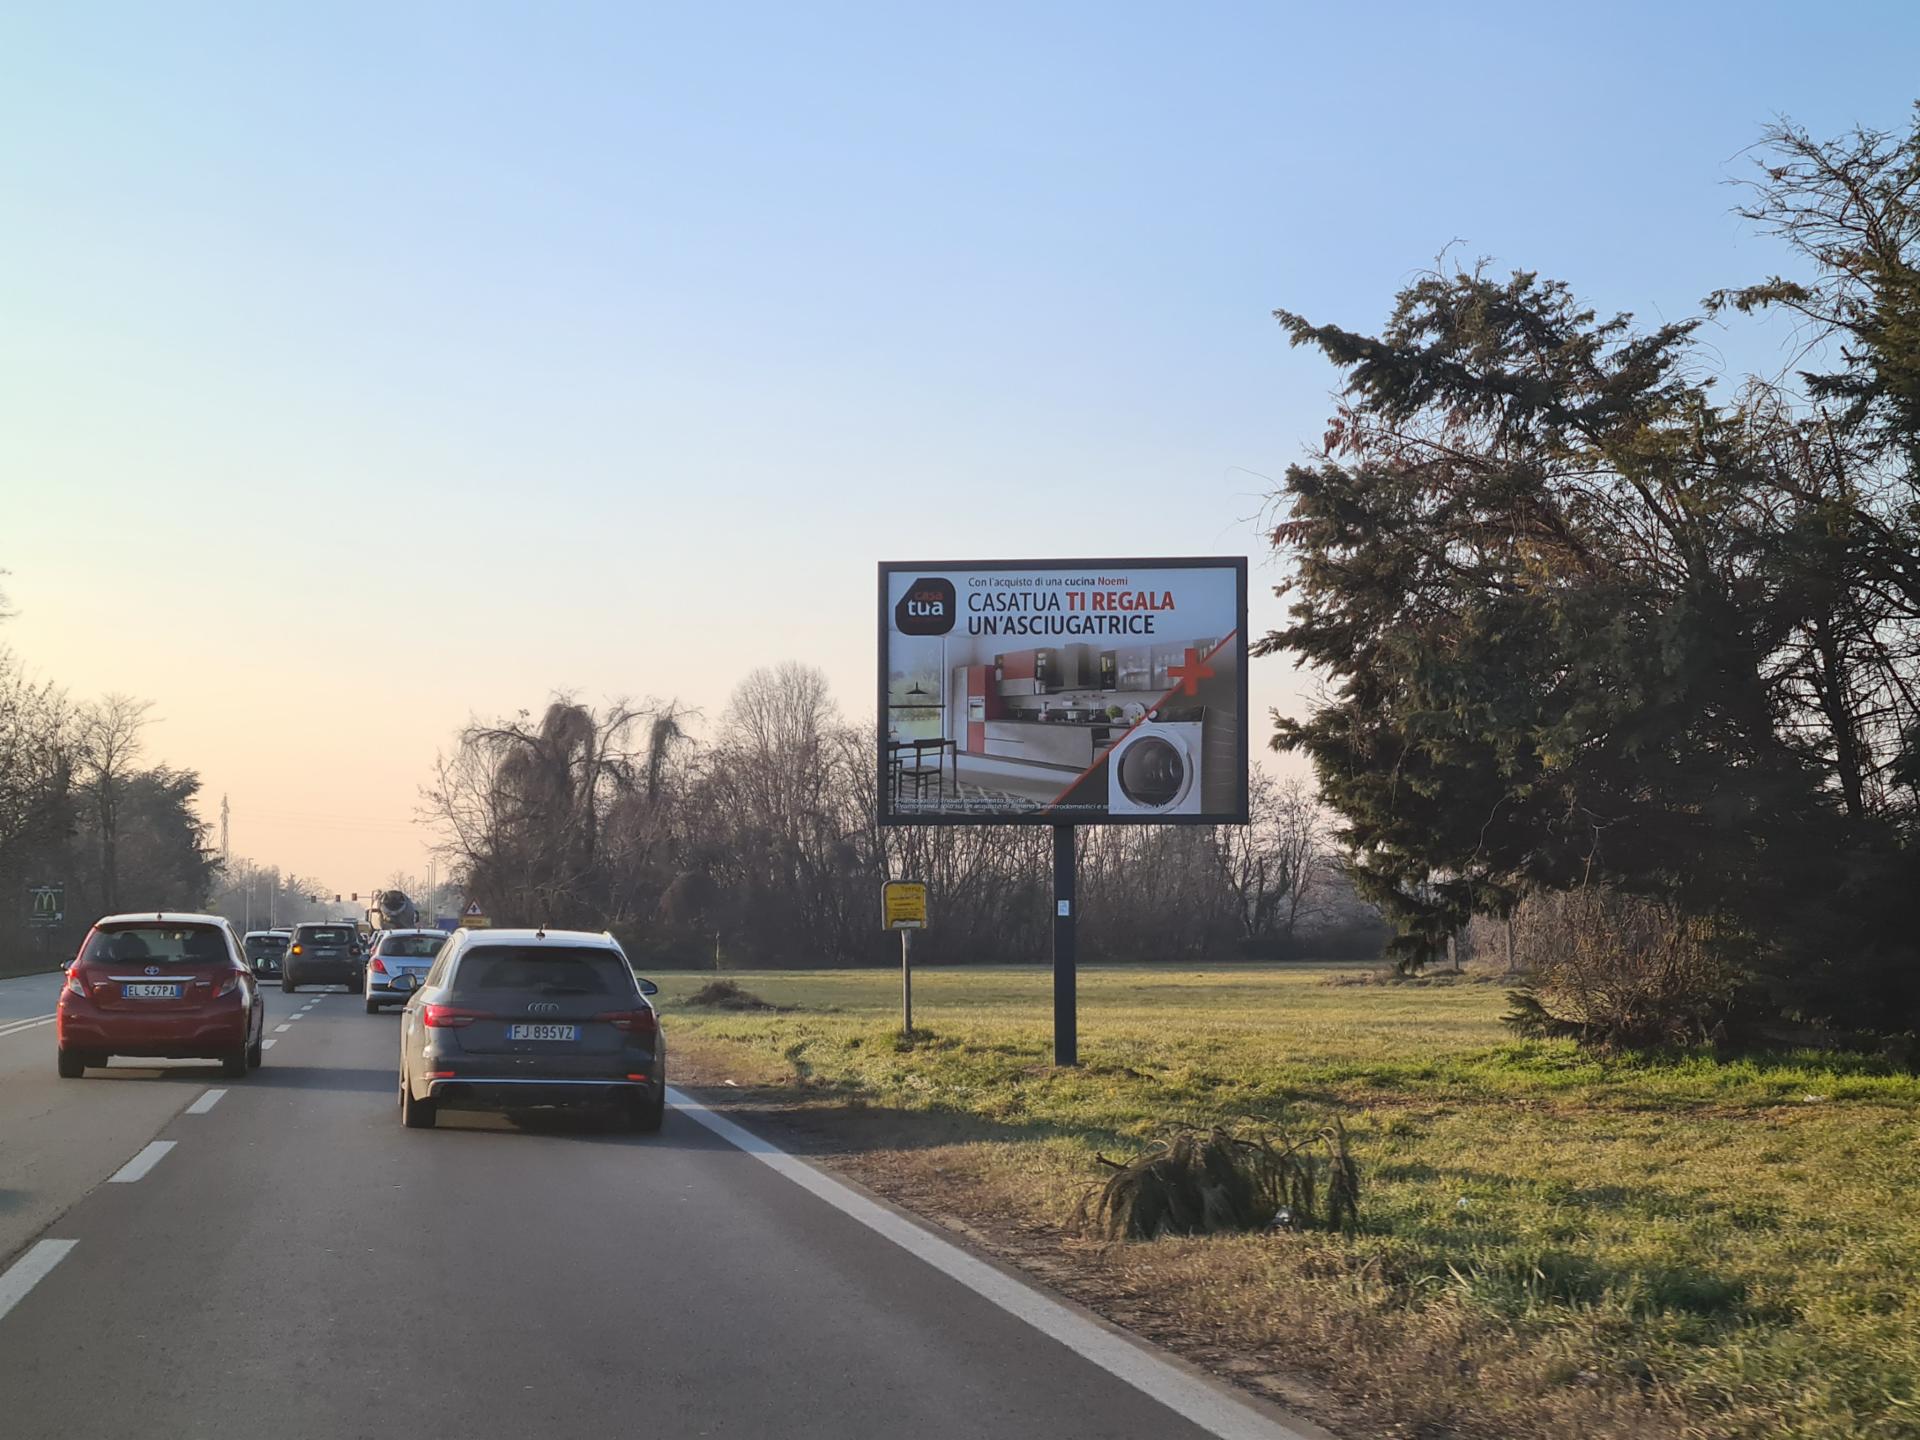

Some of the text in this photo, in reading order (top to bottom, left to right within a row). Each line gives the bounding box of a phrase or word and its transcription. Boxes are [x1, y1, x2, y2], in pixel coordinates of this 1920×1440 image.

[968, 577, 986, 587] Con
[989, 577, 1032, 588] l'acquisto
[1034, 577, 1043, 586] di
[1064, 577, 1095, 586] cucina
[1097, 576, 1128, 586] Noemi
[907, 600, 944, 616] tua
[968, 591, 1175, 612] CASATUA TI REGALA
[968, 615, 1155, 635] UN'ASCIUGATRICE
[128, 985, 175, 996] EL 547PA
[514, 1026, 573, 1039] FJ 895VZ
